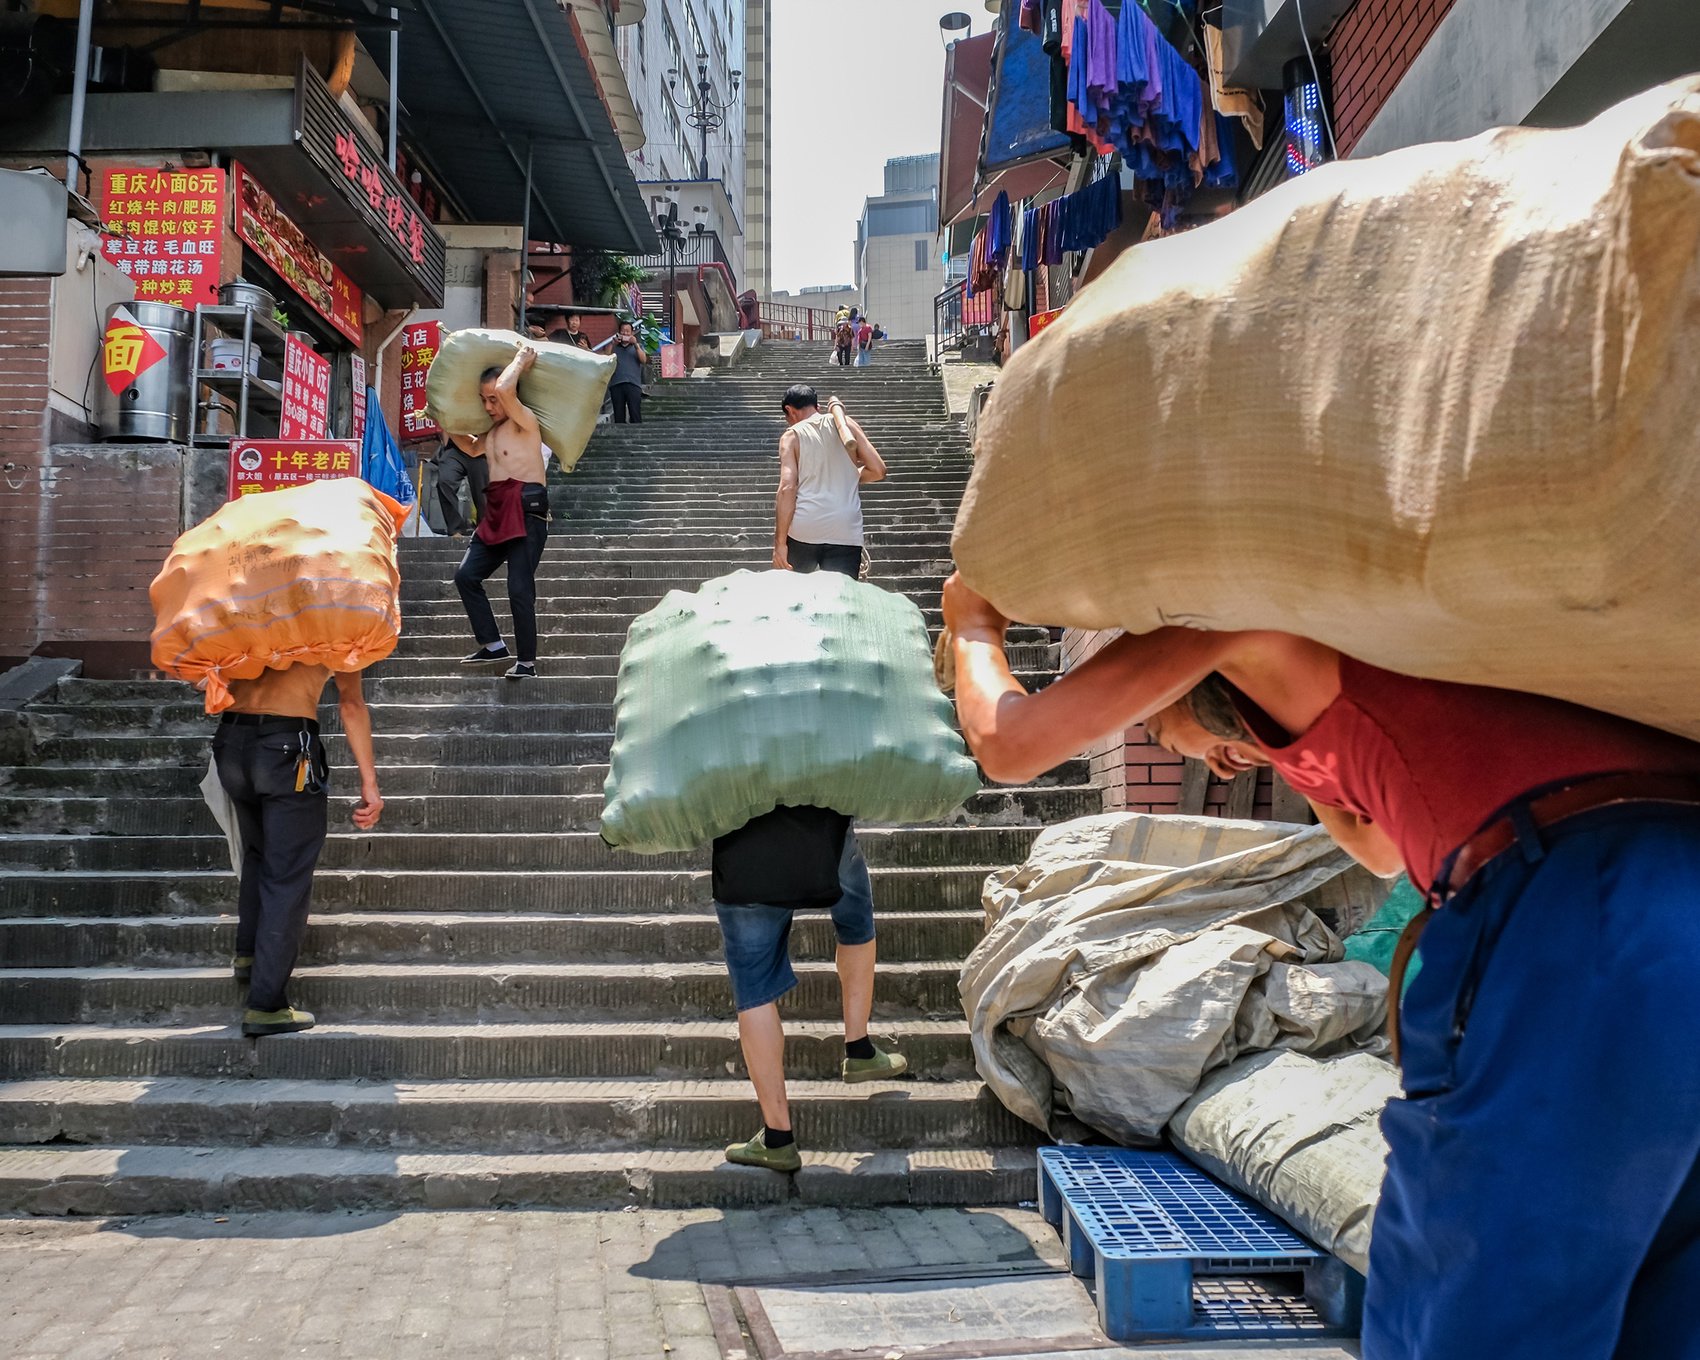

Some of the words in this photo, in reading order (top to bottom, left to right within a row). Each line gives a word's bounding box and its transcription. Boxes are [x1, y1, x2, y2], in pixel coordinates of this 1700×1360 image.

[109, 173, 218, 194] 重庆小面6元
[108, 199, 217, 215] 红烧牛肉/肥肠
[107, 219, 216, 235] 鲜肉馄饨/饺子
[106, 239, 158, 255] 荤豆花
[163, 240, 215, 255] 毛血旺
[116, 259, 203, 275] 海带蹄花汤
[134, 279, 193, 295] 种炒菜
[105, 325, 145, 375] 面
[287, 341, 316, 387] 重庆小面
[316, 364, 327, 395] 6元
[403, 371, 429, 389] 豆花
[269, 450, 351, 470] 十年老店
